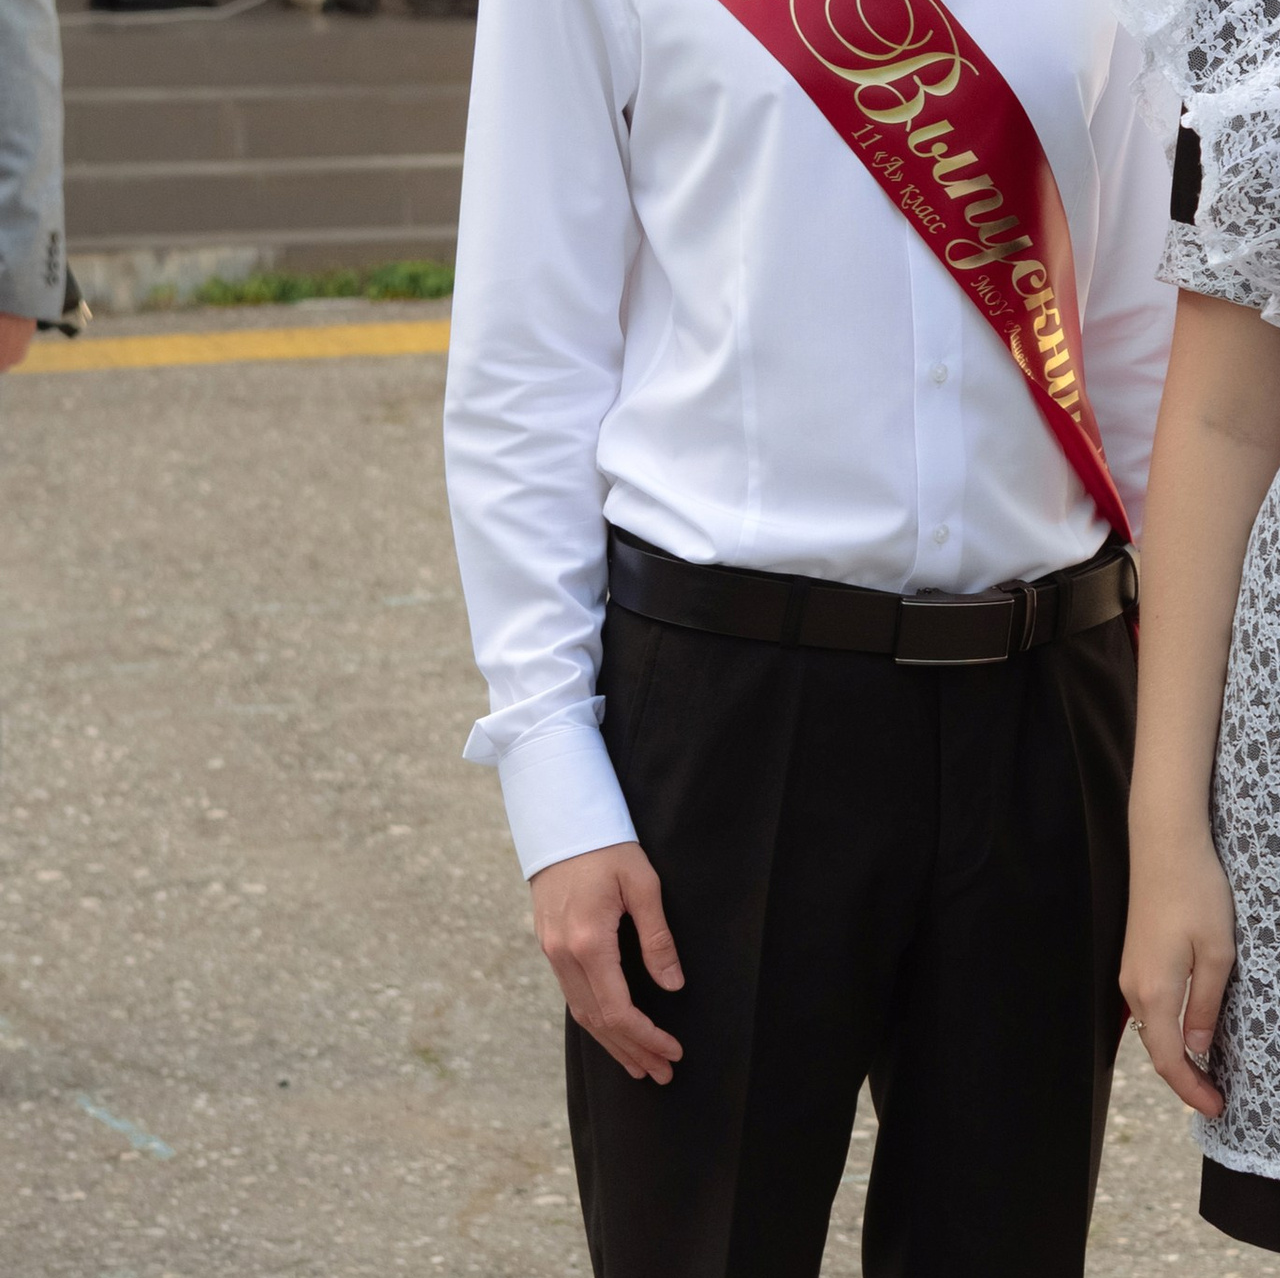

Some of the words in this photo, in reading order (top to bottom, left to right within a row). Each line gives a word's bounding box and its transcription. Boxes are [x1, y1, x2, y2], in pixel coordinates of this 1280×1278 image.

[851, 123, 883, 150] 11
[872, 151, 904, 182] «А»
[900, 183, 947, 235] класс
[970, 274, 1015, 317] МОУ
